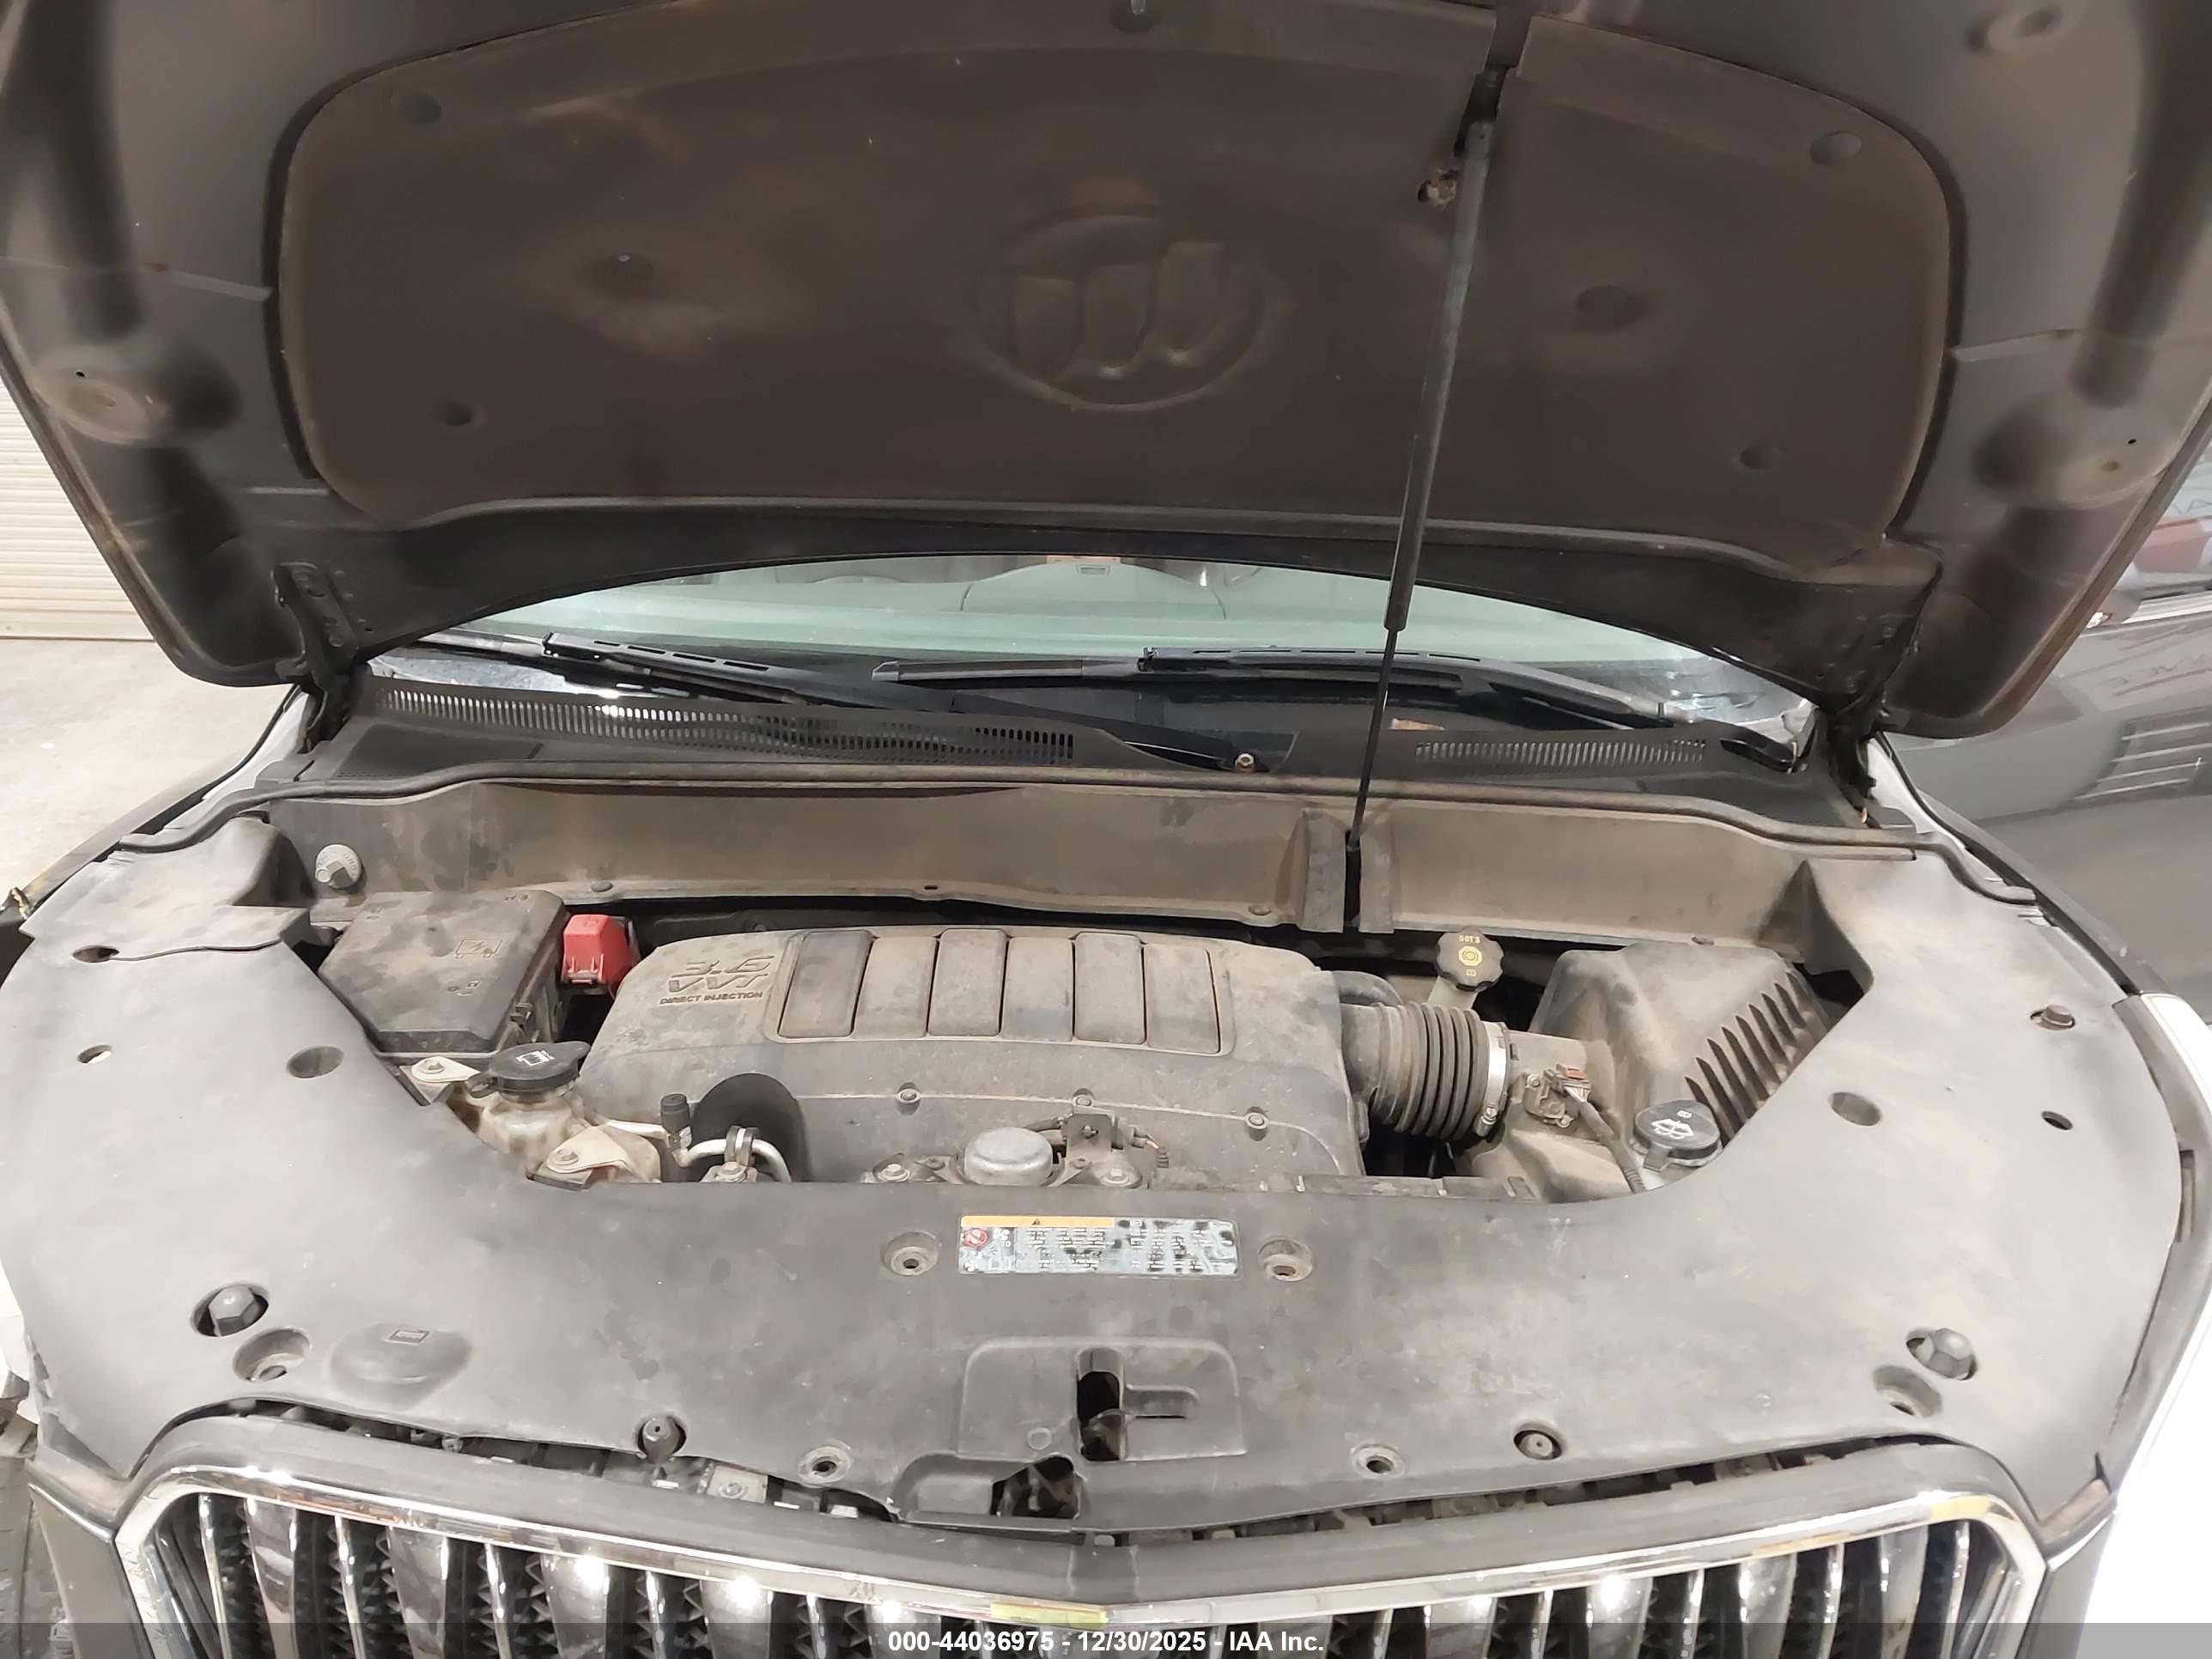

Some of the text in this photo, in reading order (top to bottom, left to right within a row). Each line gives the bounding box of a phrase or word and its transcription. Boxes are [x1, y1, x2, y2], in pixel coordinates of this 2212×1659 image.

[670, 955, 775, 978] 3.6
[668, 973, 769, 993] VVT
[659, 991, 763, 1006] DIRECT INJECTION
